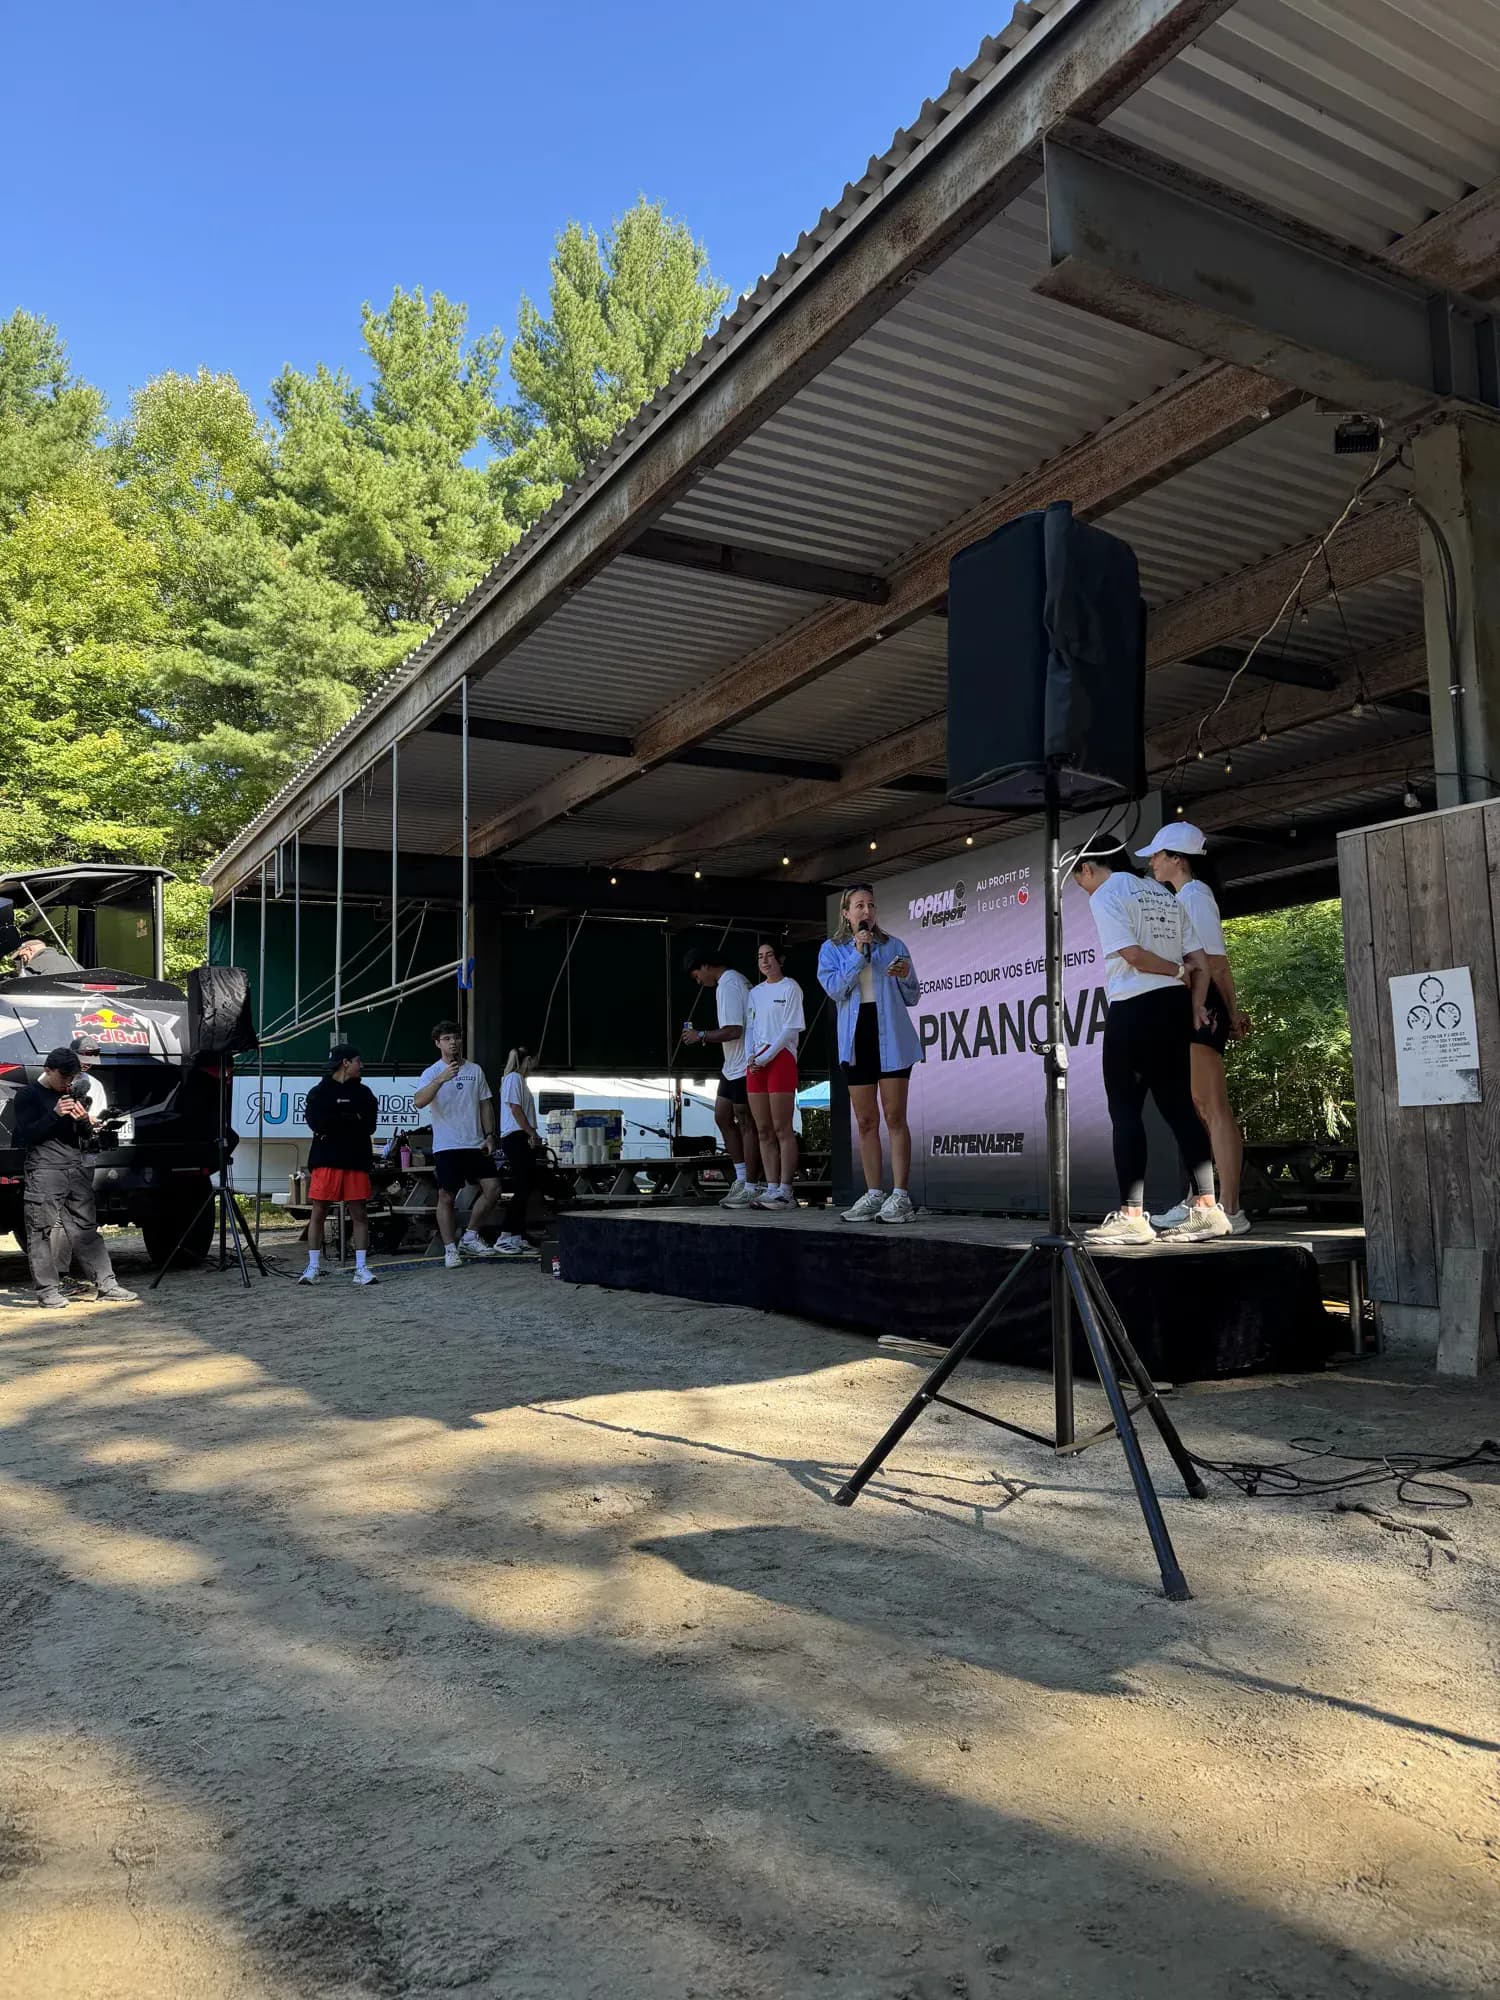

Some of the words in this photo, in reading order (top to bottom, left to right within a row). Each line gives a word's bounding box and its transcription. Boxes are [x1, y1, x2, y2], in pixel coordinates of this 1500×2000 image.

[976, 880, 987, 892] AU
[988, 871, 1017, 888] PROFIT
[1019, 867, 1031, 880] DE
[954, 974, 972, 987] LED
[974, 968, 1000, 985] POUR
[1002, 963, 1023, 979] VOS
[112, 1029, 149, 1045] Bull
[931, 1132, 1025, 1156] PARTENAIRE
